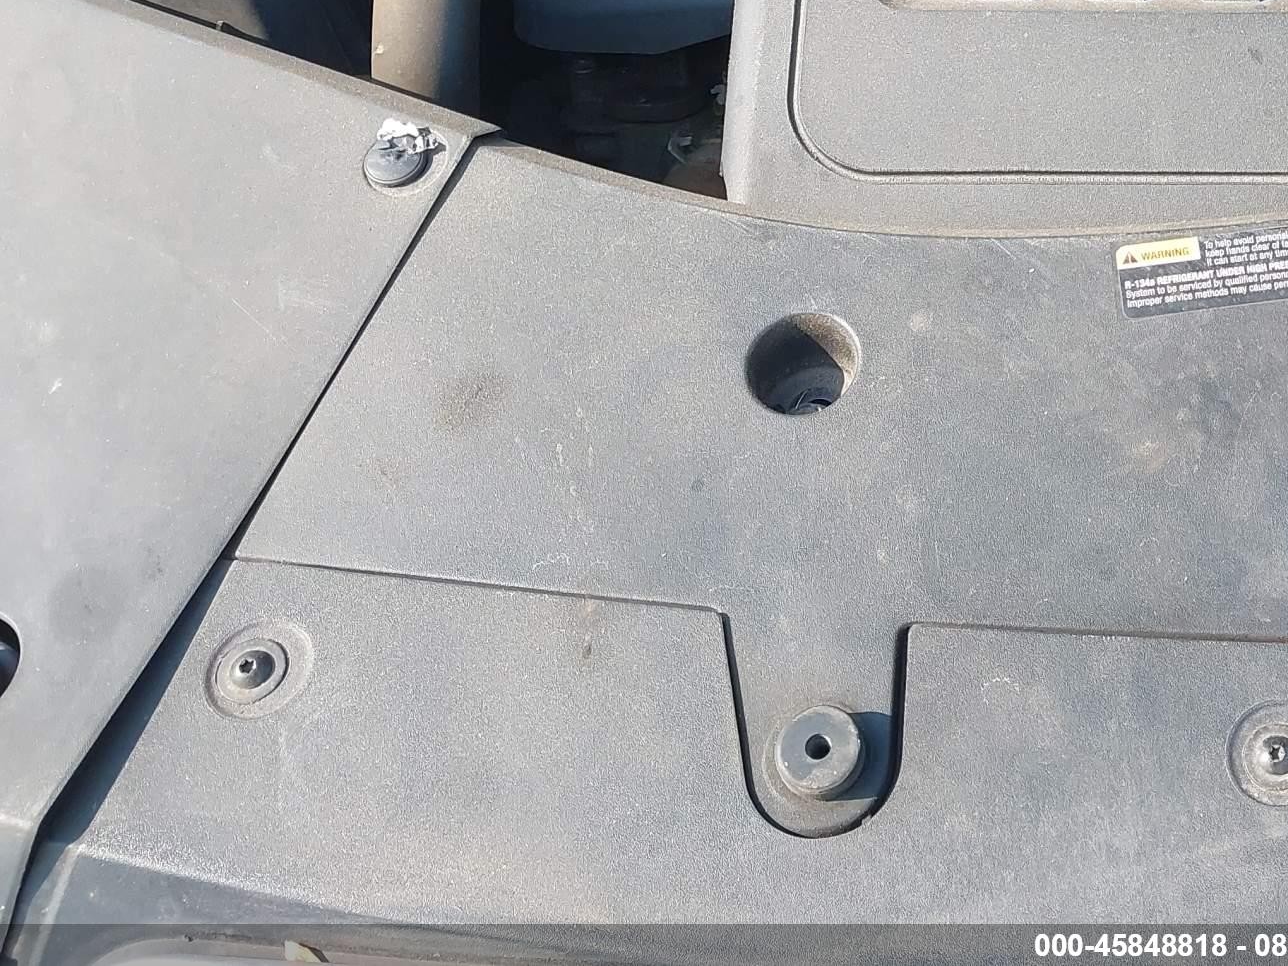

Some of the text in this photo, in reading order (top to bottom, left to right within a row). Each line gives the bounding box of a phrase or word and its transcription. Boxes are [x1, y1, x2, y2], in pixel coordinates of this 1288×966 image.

[1203, 241, 1213, 249] To
[1214, 239, 1231, 247] help
[1233, 235, 1253, 245] avoid
[1255, 231, 1288, 244] personal
[1205, 249, 1224, 257] keep
[1226, 245, 1249, 254] hands
[1251, 243, 1269, 251] clear
[1271, 241, 1279, 249] of
[1140, 246, 1189, 260] WARNING
[1230, 253, 1247, 263] start
[1249, 252, 1257, 260] at
[1156, 270, 1213, 285] REFRIGERANT
[1216, 266, 1244, 277] UNDER
[1246, 263, 1267, 273] HIGH
[1125, 288, 1154, 299] System
[1156, 286, 1165, 294] to
[1166, 284, 1176, 293] be
[1178, 279, 1212, 291] serviced
[1213, 279, 1222, 288] by
[1224, 274, 1257, 287] qualified
[1127, 297, 1162, 308] Improper
[1164, 293, 1192, 303] service
[1194, 288, 1228, 299] methods
